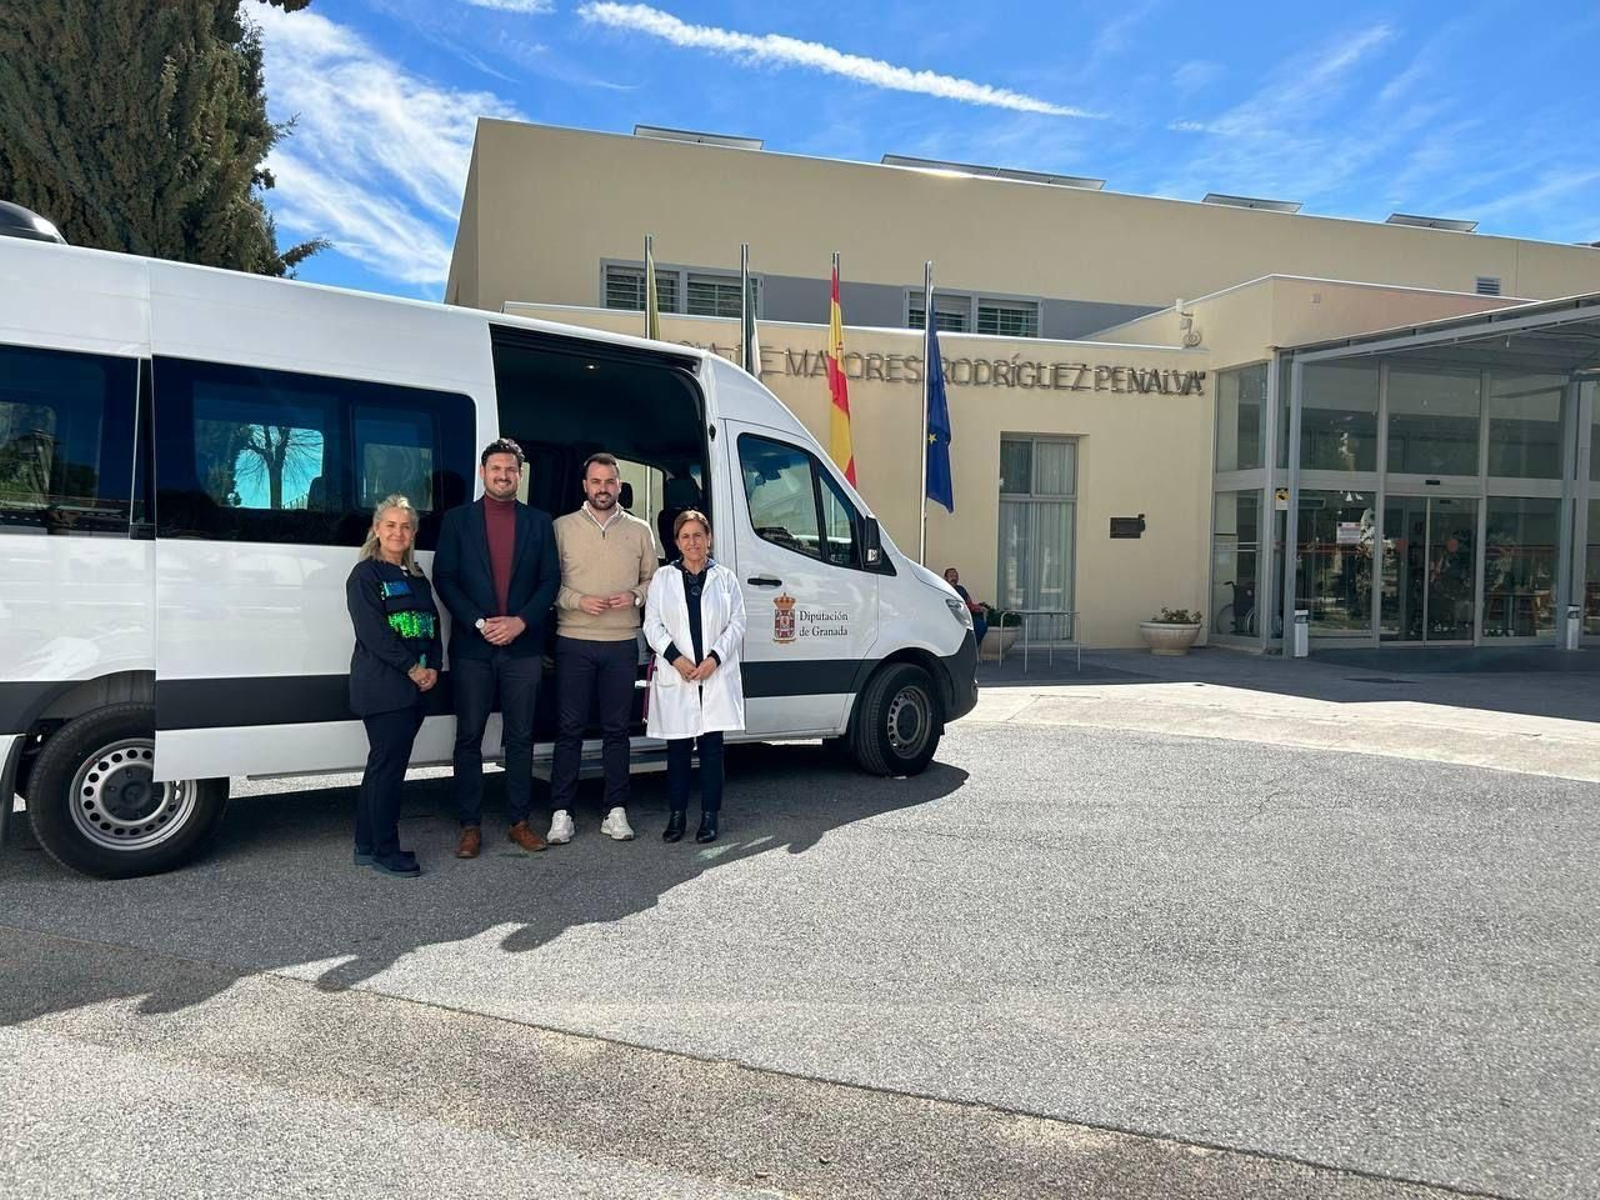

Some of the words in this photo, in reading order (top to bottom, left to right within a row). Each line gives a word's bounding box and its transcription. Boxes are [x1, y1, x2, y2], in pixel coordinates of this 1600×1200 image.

[786, 348, 921, 383] MAORES
[800, 610, 848, 623] Diputación
[799, 625, 810, 636] de
[811, 625, 848, 637] Granada
